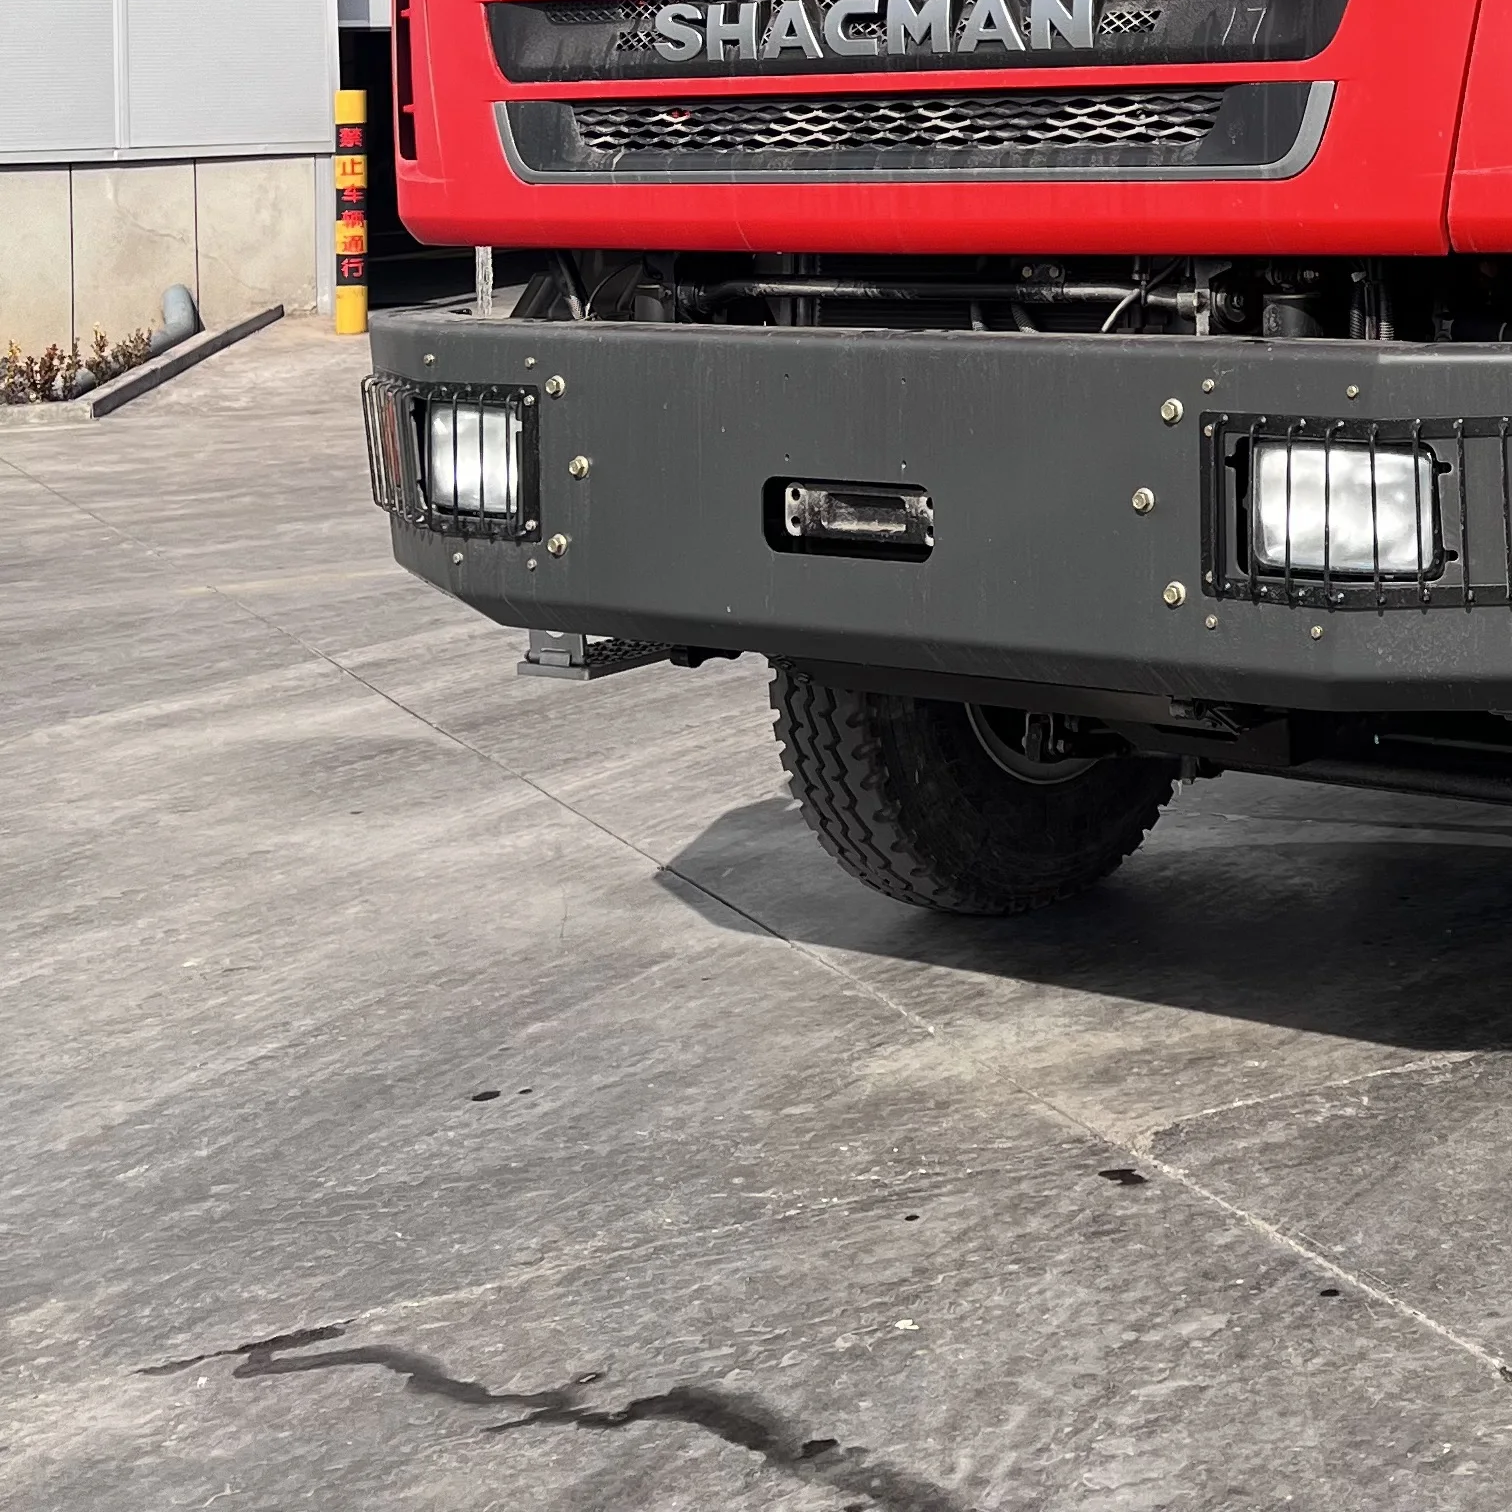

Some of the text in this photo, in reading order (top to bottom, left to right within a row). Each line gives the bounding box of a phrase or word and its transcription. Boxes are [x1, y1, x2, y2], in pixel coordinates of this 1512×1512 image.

[339, 126, 364, 278] 禁止车辆通行
